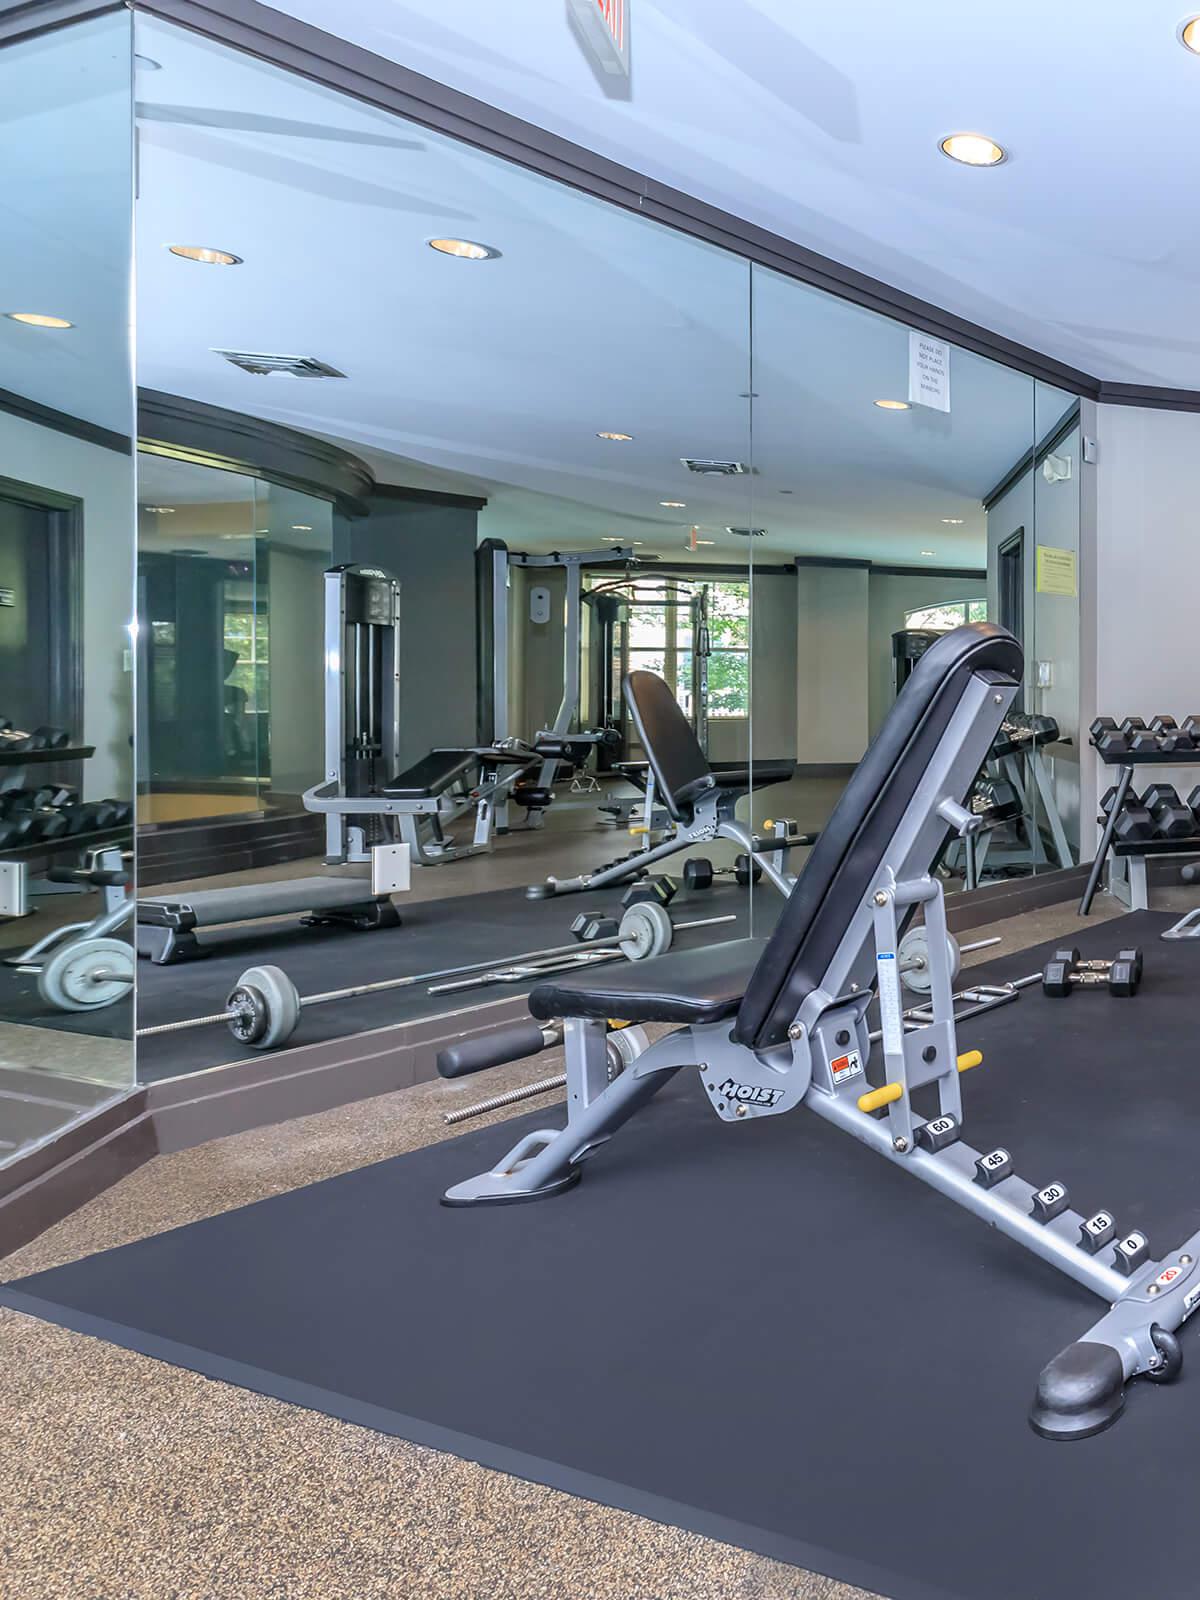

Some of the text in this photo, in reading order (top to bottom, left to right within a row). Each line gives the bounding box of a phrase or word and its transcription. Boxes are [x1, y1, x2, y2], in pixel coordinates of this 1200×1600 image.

[919, 342, 934, 353] PLEASE
[919, 351, 943, 366] NOT PLACE
[720, 1082, 785, 1104] HOIST
[932, 1120, 949, 1132] 60
[988, 1153, 1004, 1166] 45
[1043, 1187, 1060, 1202] 30
[1092, 1217, 1108, 1230] 15
[1127, 1239, 1138, 1250] 0
[1160, 1270, 1178, 1281] 20
